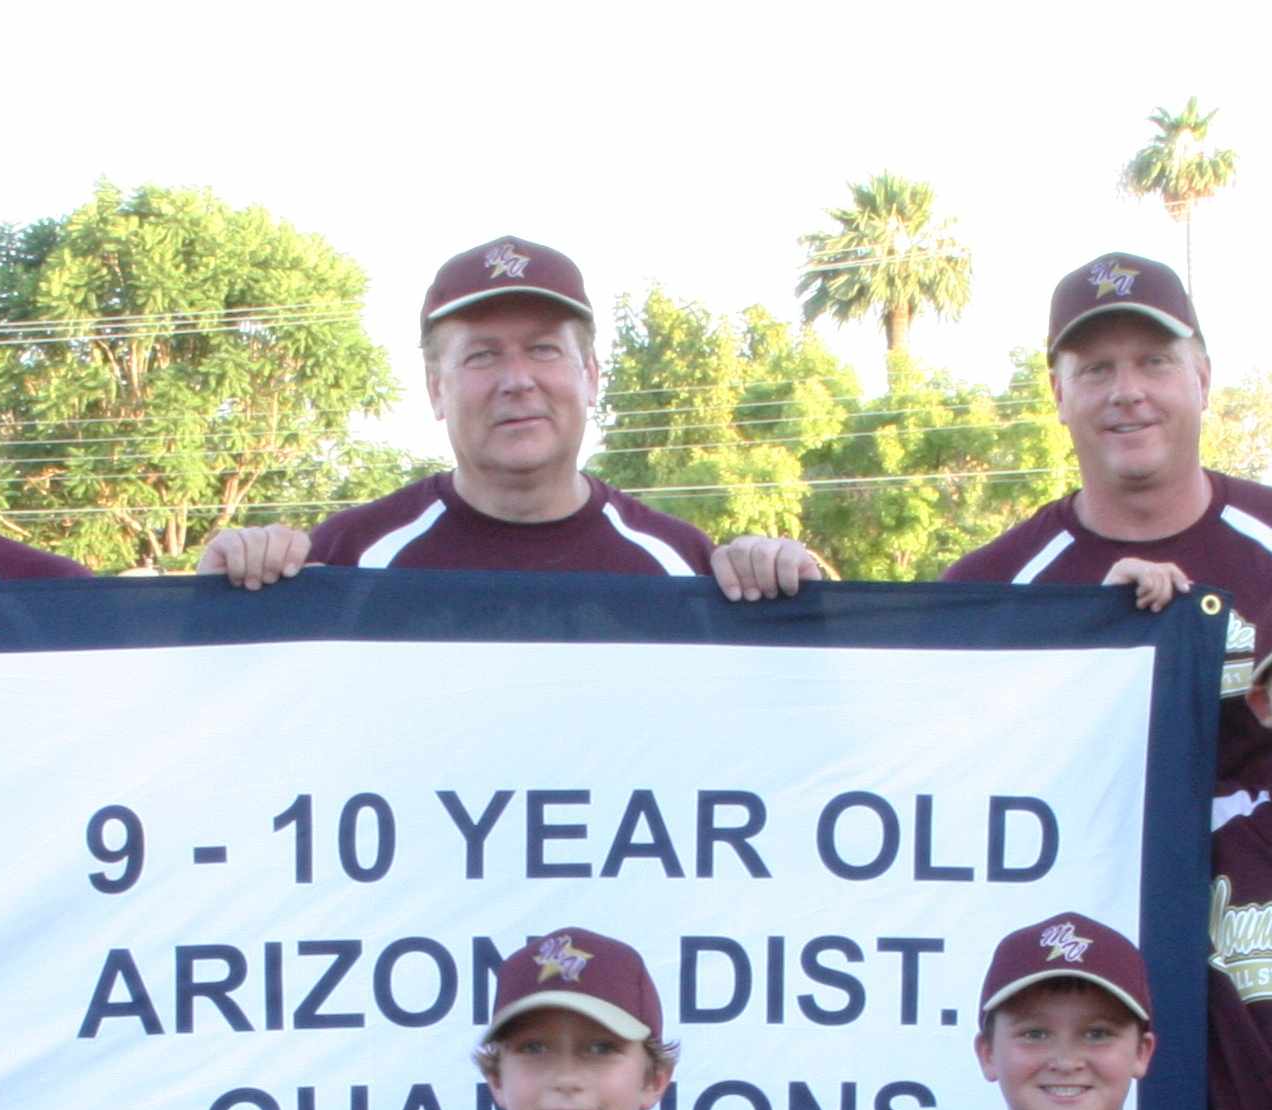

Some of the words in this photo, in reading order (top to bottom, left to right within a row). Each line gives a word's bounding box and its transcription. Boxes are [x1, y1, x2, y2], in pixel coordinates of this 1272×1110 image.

[86, 804, 145, 894] 9
[193, 846, 227, 864] -
[272, 792, 396, 884] 10
[434, 788, 772, 880] YEAR
[816, 790, 1060, 883] OLD
[77, 936, 544, 1038] ARIZO
[679, 935, 958, 1026] DIST.
